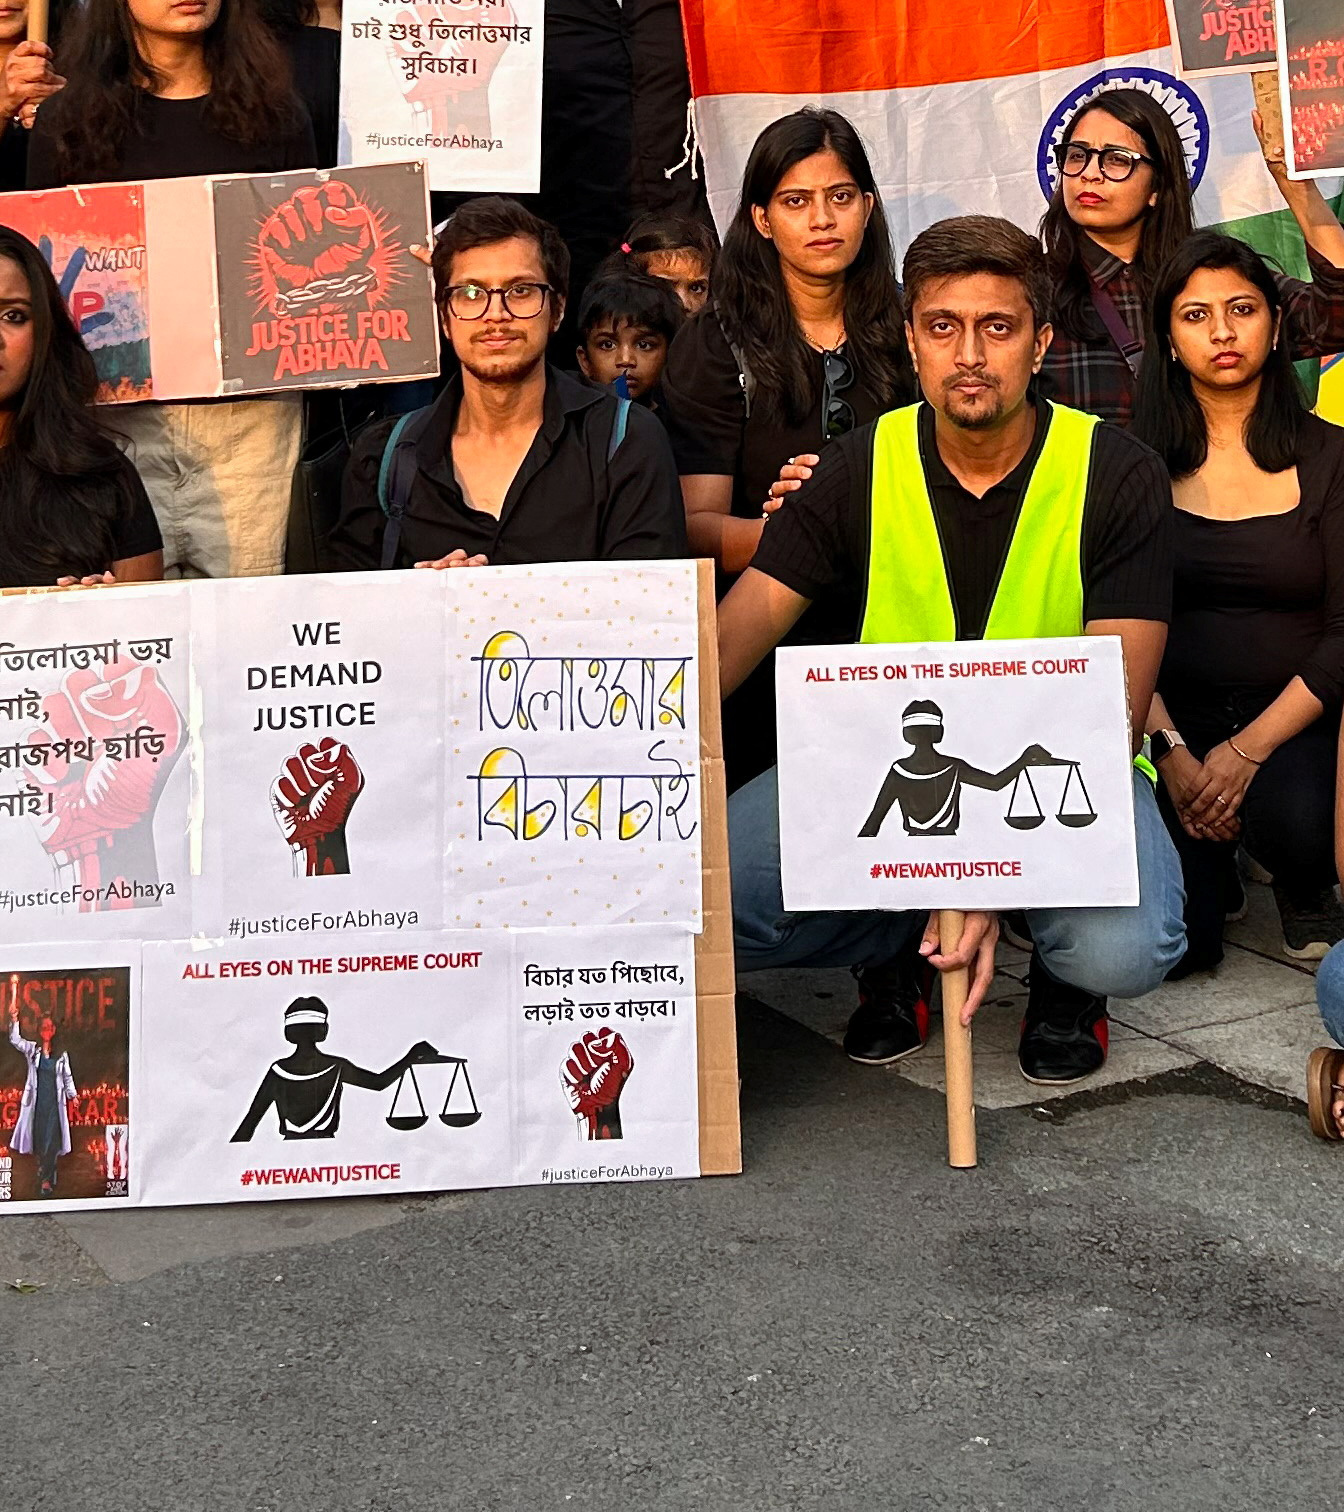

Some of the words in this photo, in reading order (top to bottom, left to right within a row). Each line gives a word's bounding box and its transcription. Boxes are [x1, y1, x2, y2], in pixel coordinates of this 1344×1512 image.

[351, 18, 383, 40] চাই
[389, 24, 423, 48] শুধু
[429, 19, 532, 45] তিলোত্তমার
[401, 52, 477, 81] সুবিচার।
[366, 134, 503, 153] #justiceForAbhaya
[84, 244, 146, 274] WANT
[245, 314, 351, 358] JUSTICE
[358, 310, 411, 344] FOR
[273, 336, 388, 381] ABHAYA
[291, 621, 342, 647] WE
[128, 636, 173, 665] ভয়
[246, 659, 383, 691] DEMAND
[805, 668, 836, 683] ALL
[840, 666, 878, 681] EYES
[883, 664, 907, 680] ON
[911, 663, 944, 679] THE
[949, 661, 1027, 678] SUPREME
[1032, 658, 1089, 675] COURT
[253, 701, 377, 732] JUSTICE
[103, 726, 166, 763] ছাড়ি
[869, 861, 1022, 881] #WEWANTJUSTICE
[227, 907, 420, 938] #justiceForAbhaya
[182, 962, 215, 982] ALL
[217, 959, 263, 979] EYES
[266, 957, 294, 977] ON
[297, 955, 334, 976] THE
[337, 953, 418, 975] SUPREME
[423, 951, 483, 971] COURT
[524, 963, 573, 990] বিচার
[578, 966, 607, 987] যত
[610, 960, 685, 987] পিছোবে,
[524, 997, 574, 1023] লড়াই
[579, 1001, 610, 1020] তত
[614, 997, 677, 1021] বাড়বে।
[67, 1098, 119, 1122] KAR
[239, 1163, 401, 1187] #WEWANTJUSTICE
[540, 1163, 675, 1183] #justiceForAbhaya
